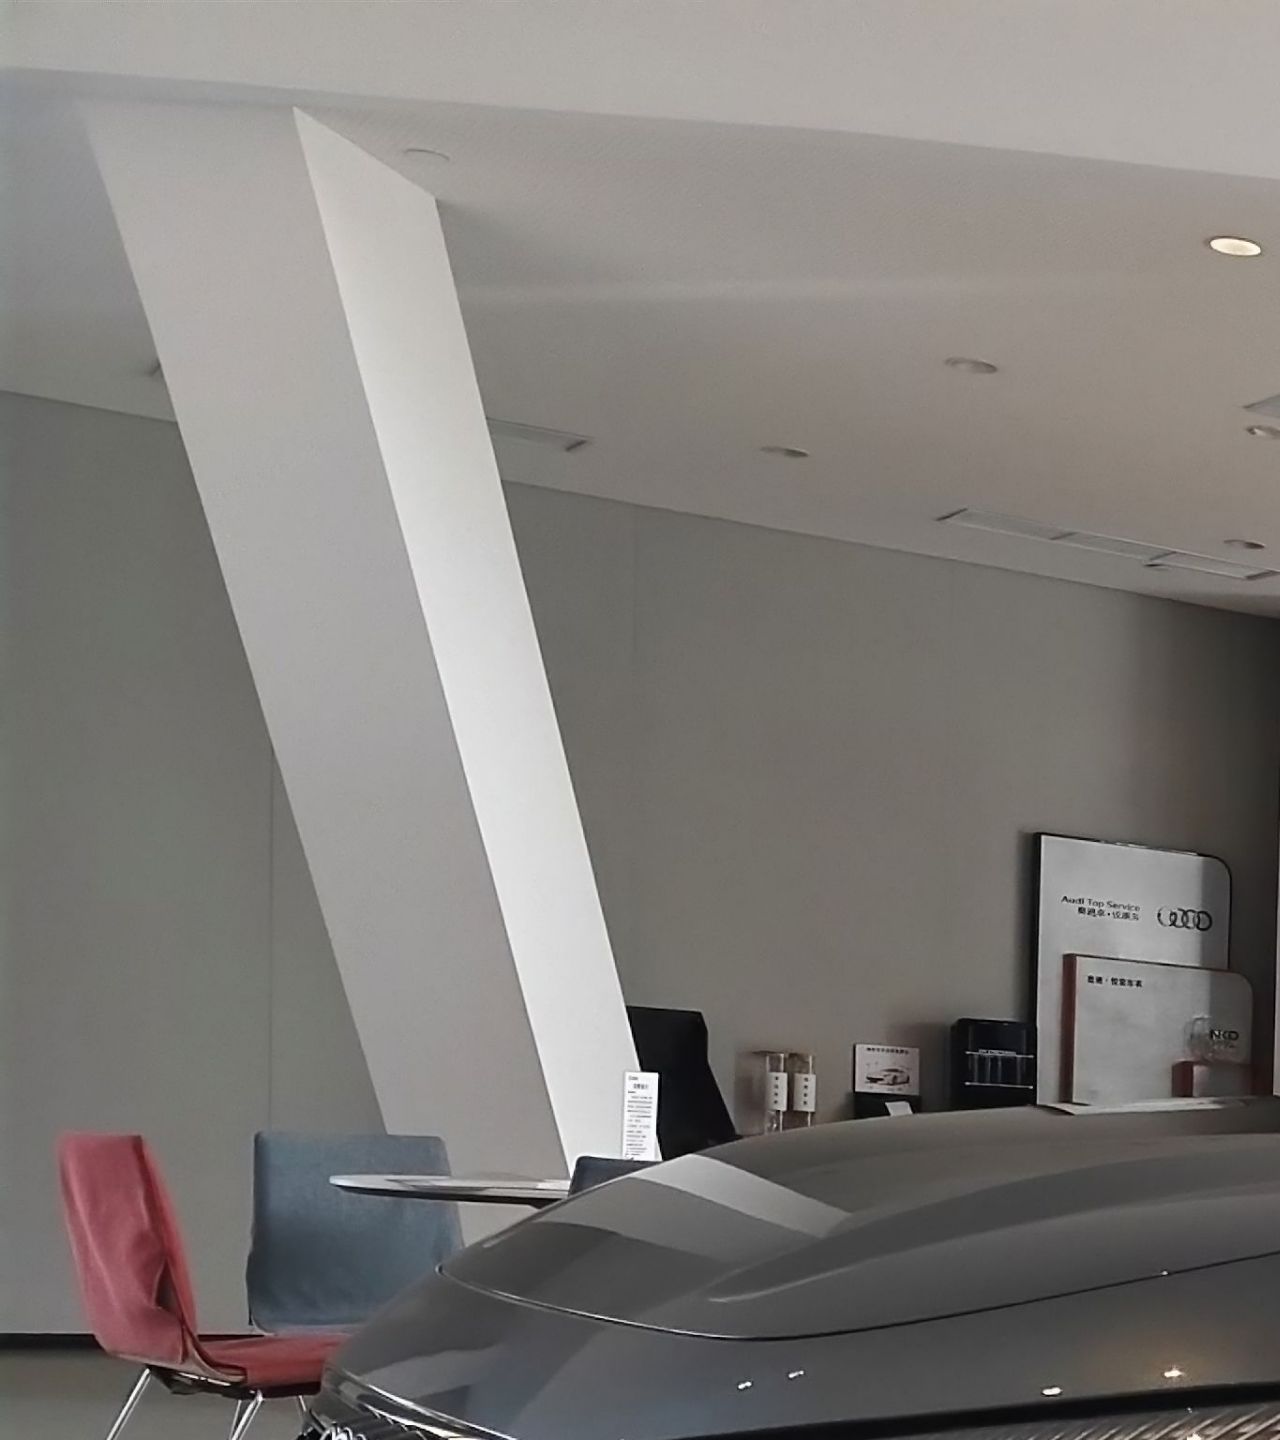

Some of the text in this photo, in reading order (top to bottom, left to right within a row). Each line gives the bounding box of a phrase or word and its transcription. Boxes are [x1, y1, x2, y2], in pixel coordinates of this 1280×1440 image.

[1061, 896, 1140, 912] Audi Top Service
